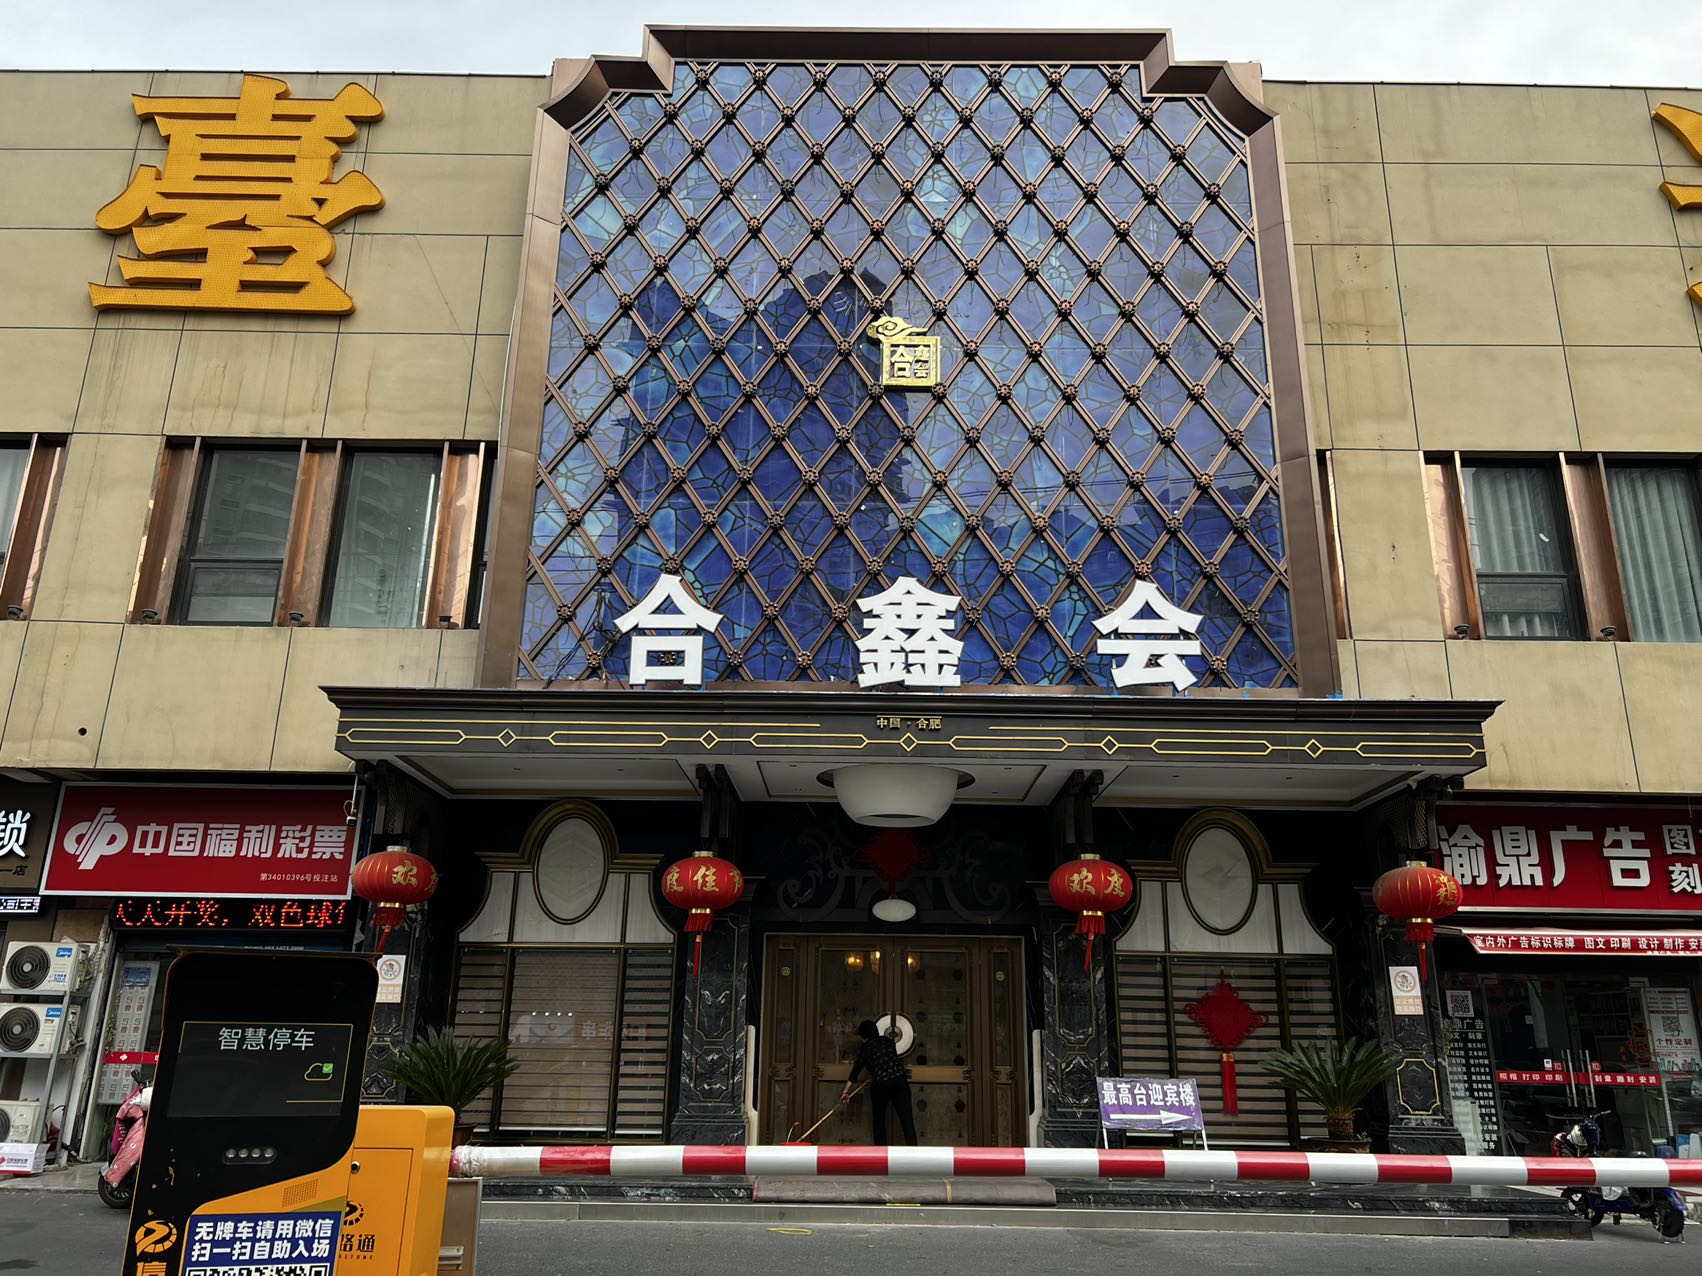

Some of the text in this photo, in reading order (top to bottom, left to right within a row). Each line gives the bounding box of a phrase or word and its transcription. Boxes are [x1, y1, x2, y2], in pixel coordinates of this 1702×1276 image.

[614, 573, 1203, 692] 合鑫会
[133, 823, 347, 860] 中国福利彩票
[1437, 824, 1652, 888] 渝鼎广告
[260, 872, 338, 882] 第34010396号投注站
[1473, 935, 1702, 950] 室内外广告标识标牌 图文 印刷 设计 制作 安
[218, 1027, 315, 1051] 智慧停车
[1102, 1081, 1196, 1107] 最高台迎宾楼
[194, 1219, 334, 1241] 无牌车请用微信
[191, 1239, 330, 1262] 扫一扫自助入场
